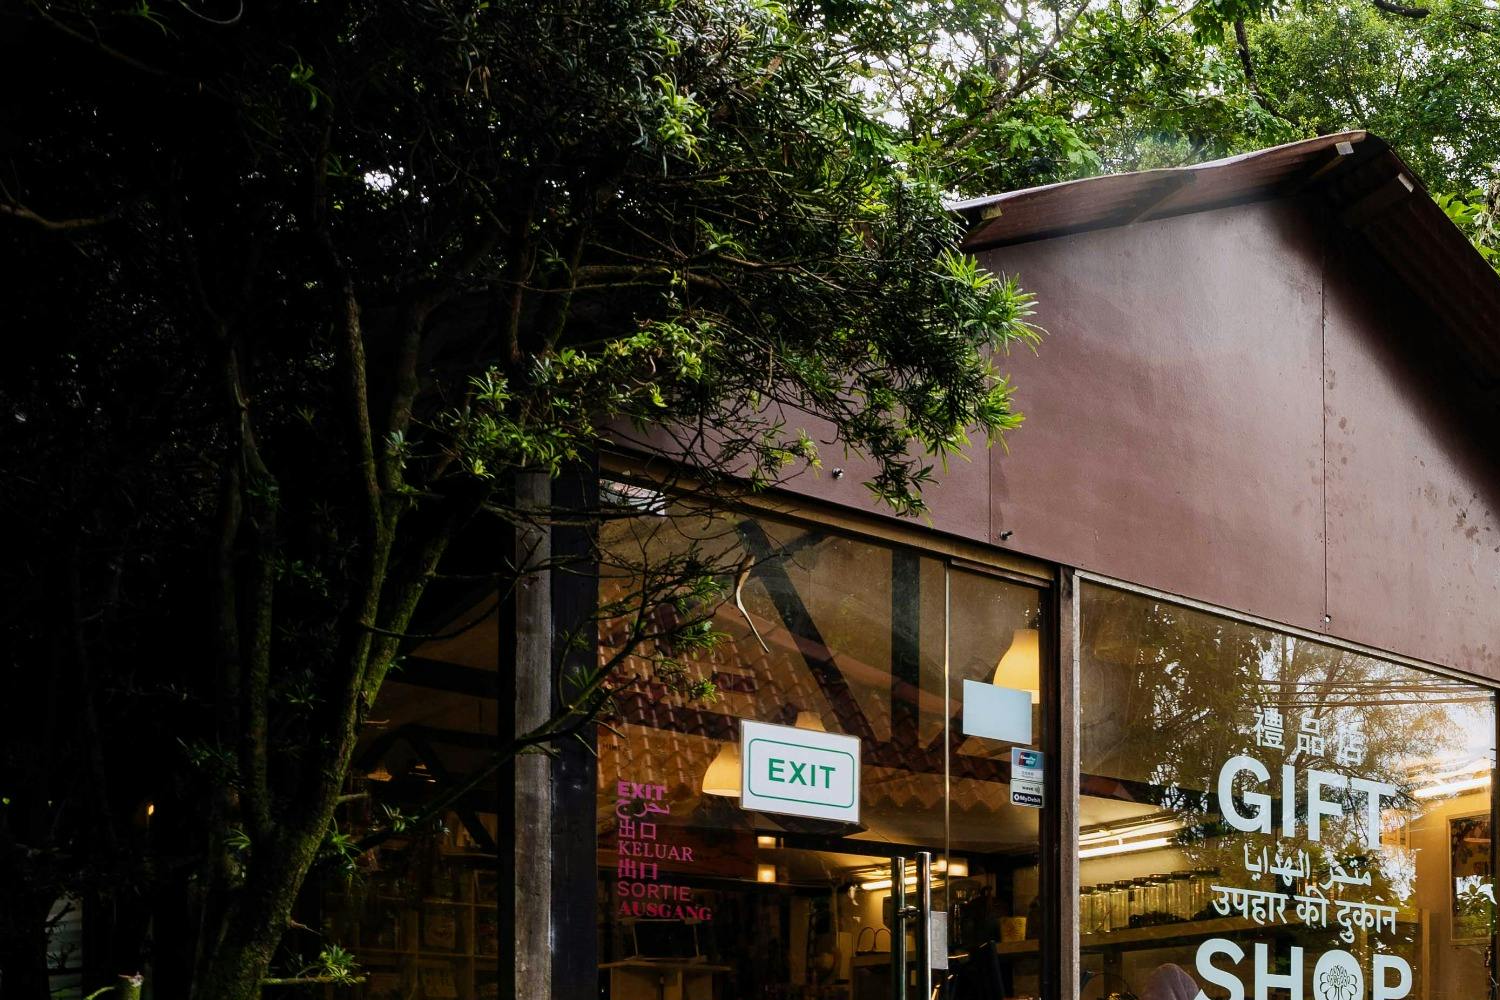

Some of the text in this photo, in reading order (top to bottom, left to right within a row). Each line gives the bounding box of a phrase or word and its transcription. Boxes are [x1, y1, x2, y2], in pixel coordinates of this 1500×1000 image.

[768, 757, 837, 789] EXIT
[617, 780, 664, 799] EXIT
[1218, 755, 1397, 851] GIFT
[619, 816, 655, 839] 出口
[618, 840, 694, 862] KELUAR
[617, 858, 658, 882] 出口
[616, 880, 692, 903] SORTIE
[619, 902, 711, 920] AUSGANG
[1211, 885, 1400, 944] उपहार की दुकान
